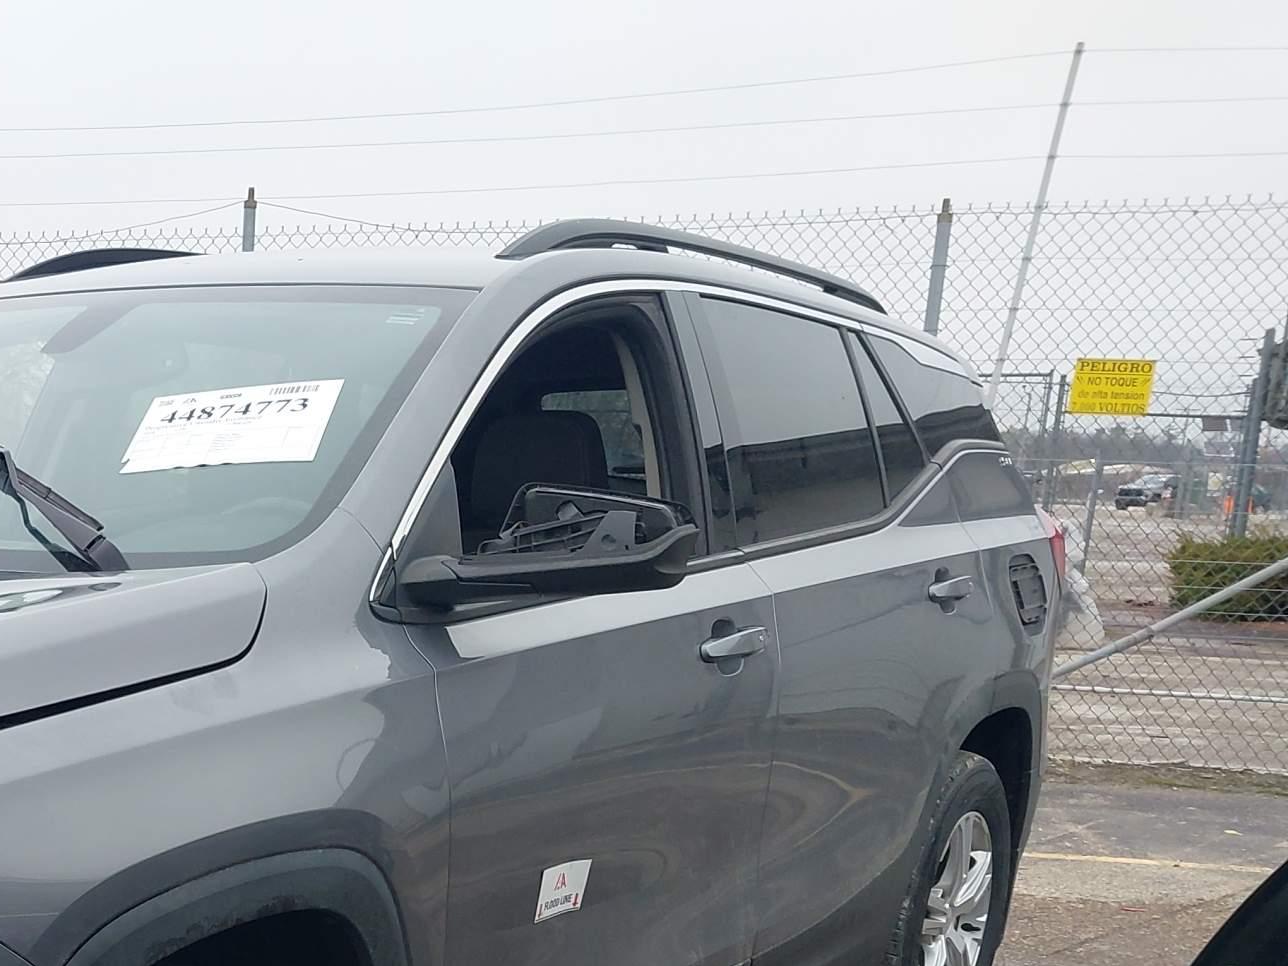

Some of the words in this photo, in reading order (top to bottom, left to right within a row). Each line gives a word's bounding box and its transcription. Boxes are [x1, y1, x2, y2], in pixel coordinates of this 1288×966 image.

[1079, 361, 1153, 374] PELIGRO
[1087, 376, 1102, 386] NO
[1105, 377, 1139, 388] TOQUE
[160, 397, 310, 424] 44874773
[1098, 402, 1146, 414] VOLTIOS
